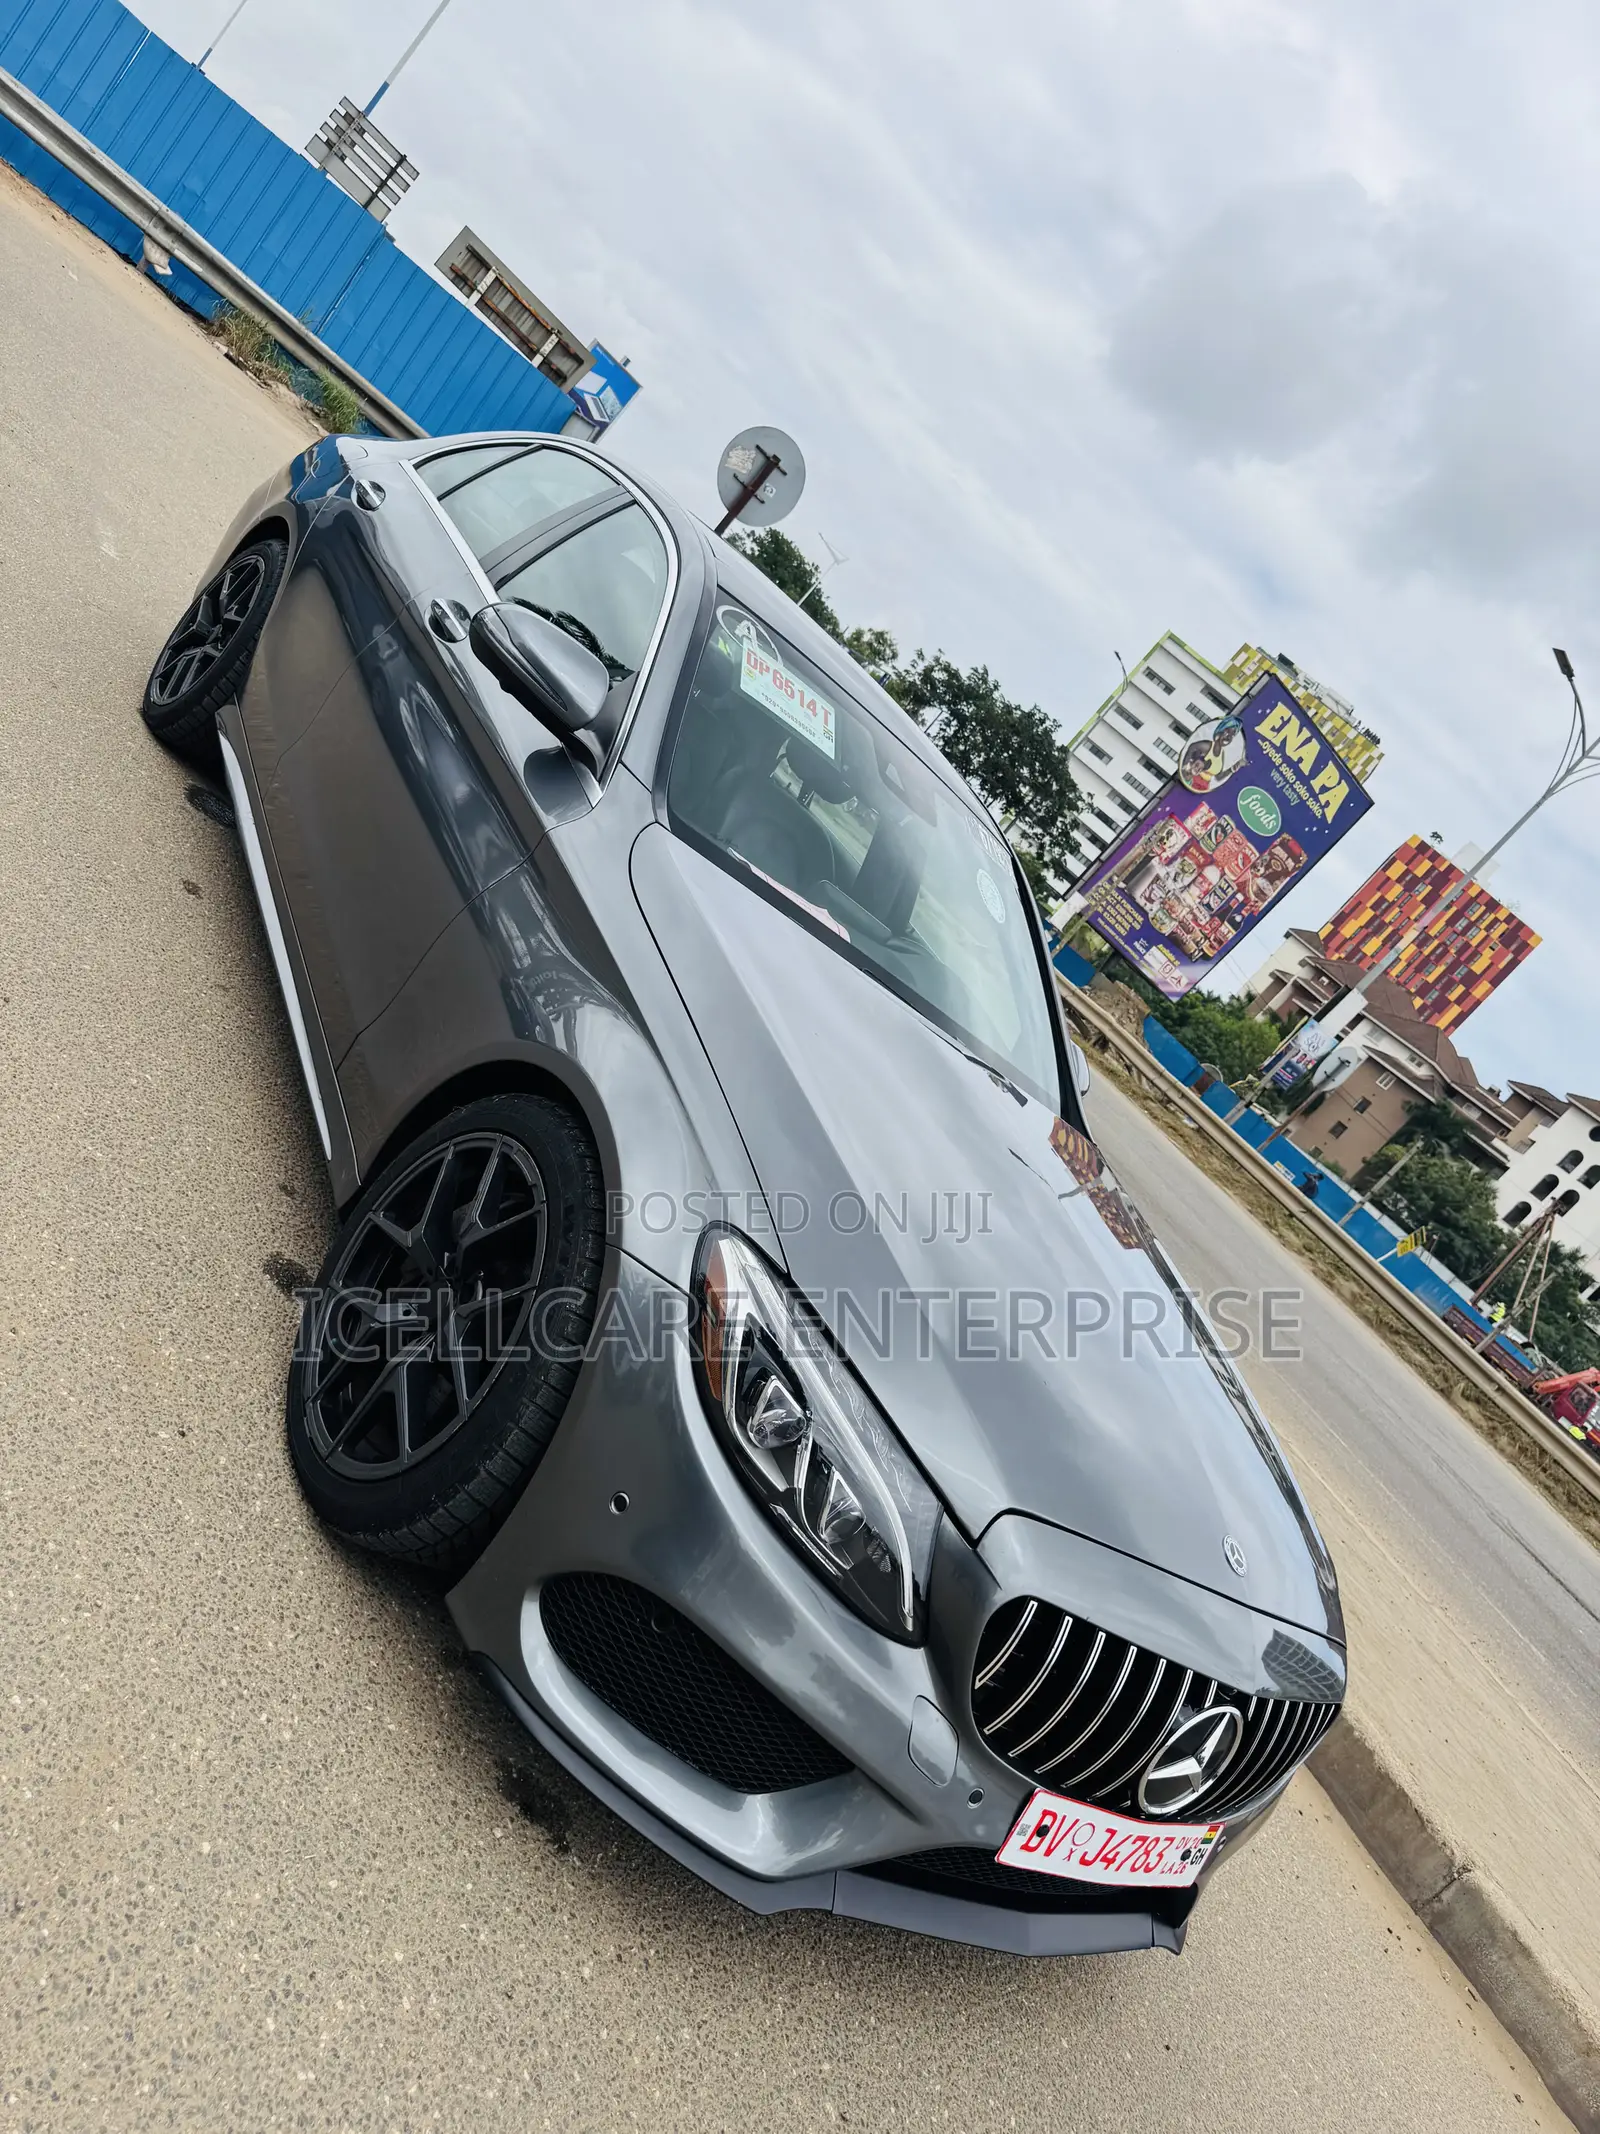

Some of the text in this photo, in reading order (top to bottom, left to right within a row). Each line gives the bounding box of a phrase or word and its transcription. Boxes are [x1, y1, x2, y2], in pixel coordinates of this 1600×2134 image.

[772, 669, 818, 718] 6514
[821, 705, 832, 727] T
[1254, 701, 1350, 824] ENA PA
[1270, 768, 1300, 806] very tasty
[1280, 763, 1297, 784] soko
[1293, 780, 1309, 801] soko
[1240, 794, 1277, 830] foods
[1190, 1847, 1208, 1865] GH
